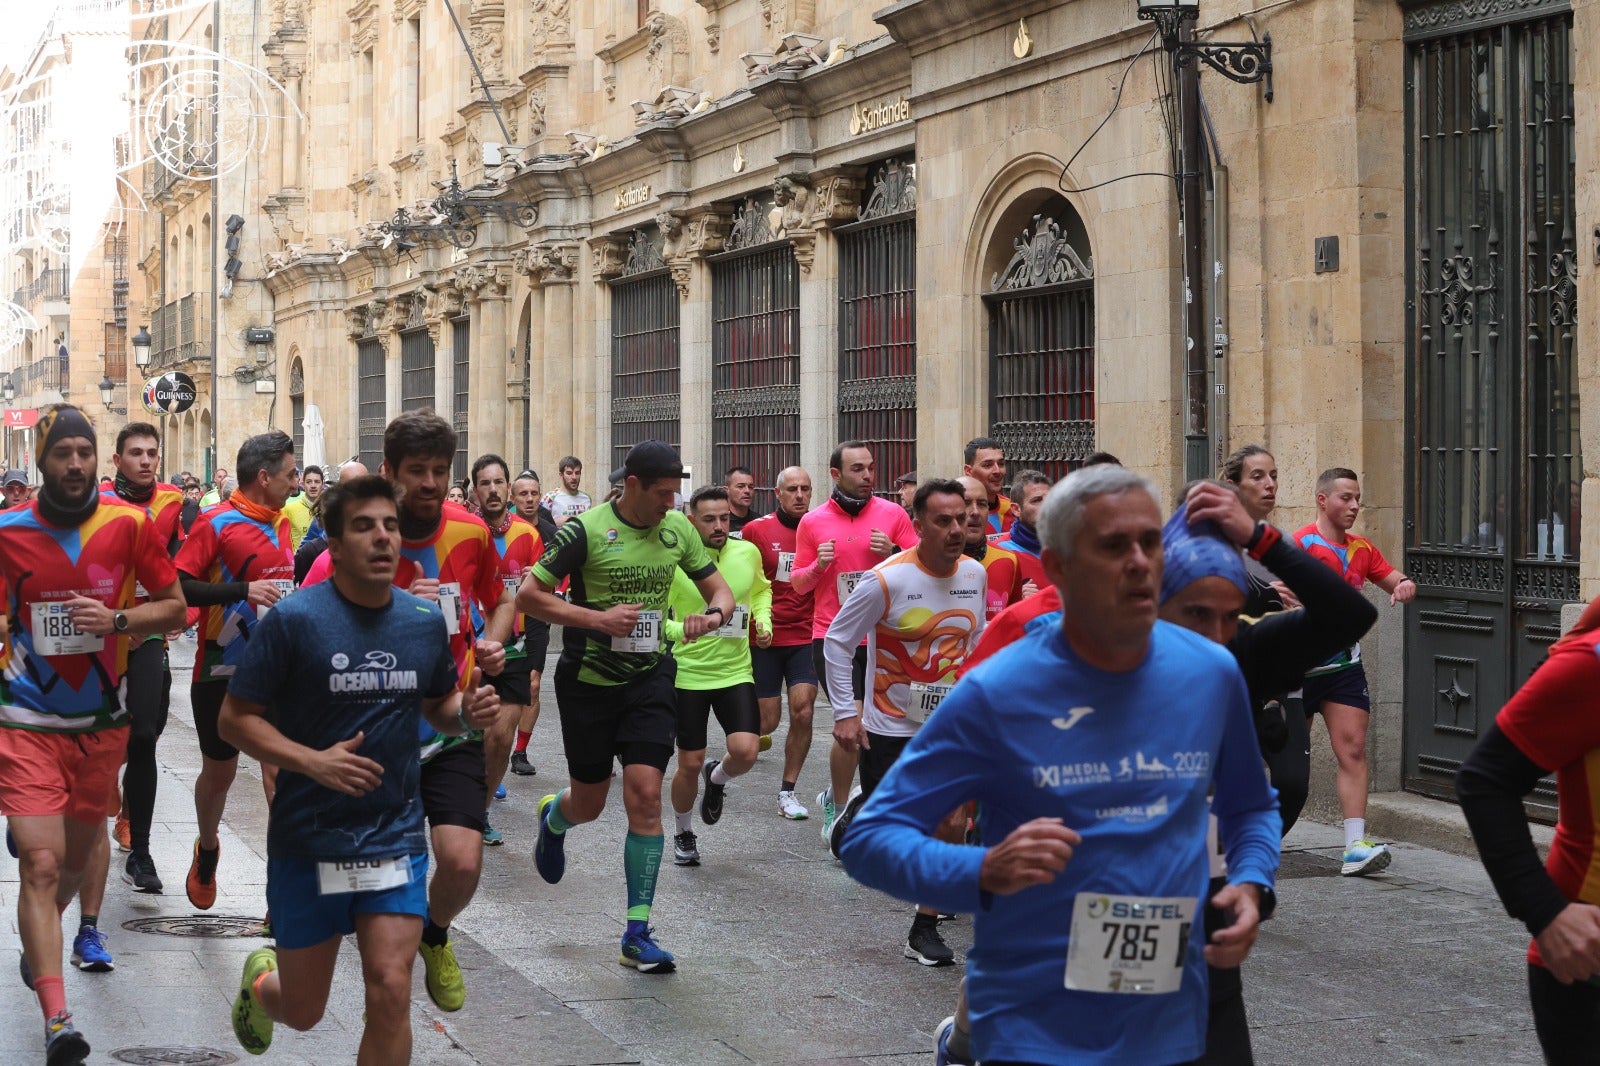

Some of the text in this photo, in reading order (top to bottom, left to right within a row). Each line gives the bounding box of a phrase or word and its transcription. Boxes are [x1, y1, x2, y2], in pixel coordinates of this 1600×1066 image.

[862, 97, 910, 131] Santander
[1318, 239, 1328, 270] 4
[157, 391, 193, 401] GUINNESS
[609, 564, 676, 580] CORRECAMINO
[609, 581, 671, 595] CARBAJOS
[611, 595, 666, 605] SALAMANC
[329, 670, 418, 692] OCEAN LAVA
[926, 685, 953, 694] SET
[1062, 762, 1110, 776] MEDIA
[1112, 902, 1184, 920] SETEL
[1102, 921, 1160, 961] 785
